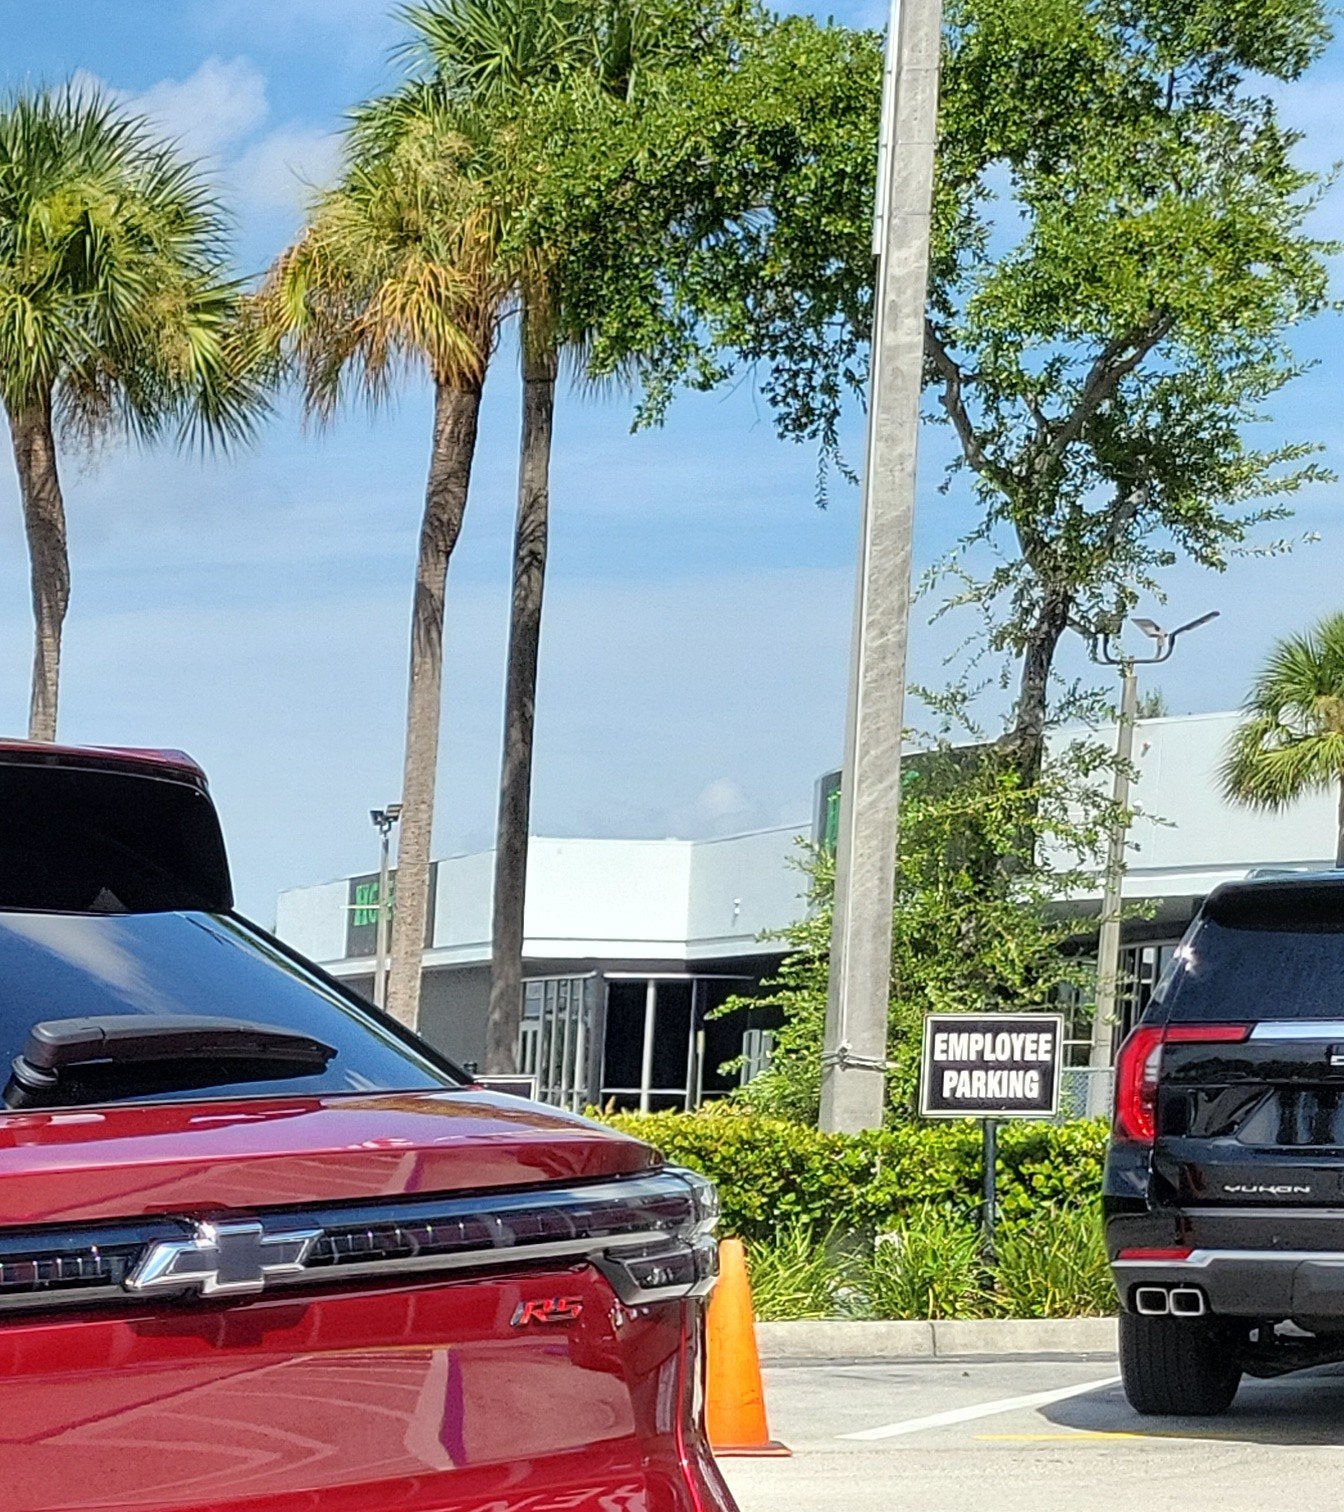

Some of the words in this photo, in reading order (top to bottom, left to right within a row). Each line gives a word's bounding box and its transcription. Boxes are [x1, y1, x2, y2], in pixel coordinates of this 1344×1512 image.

[933, 1032, 1052, 1061] EMPLOYEE
[942, 1070, 1040, 1099] PARKING
[1224, 1184, 1311, 1194] YUKON
[510, 1295, 583, 1326] RS
